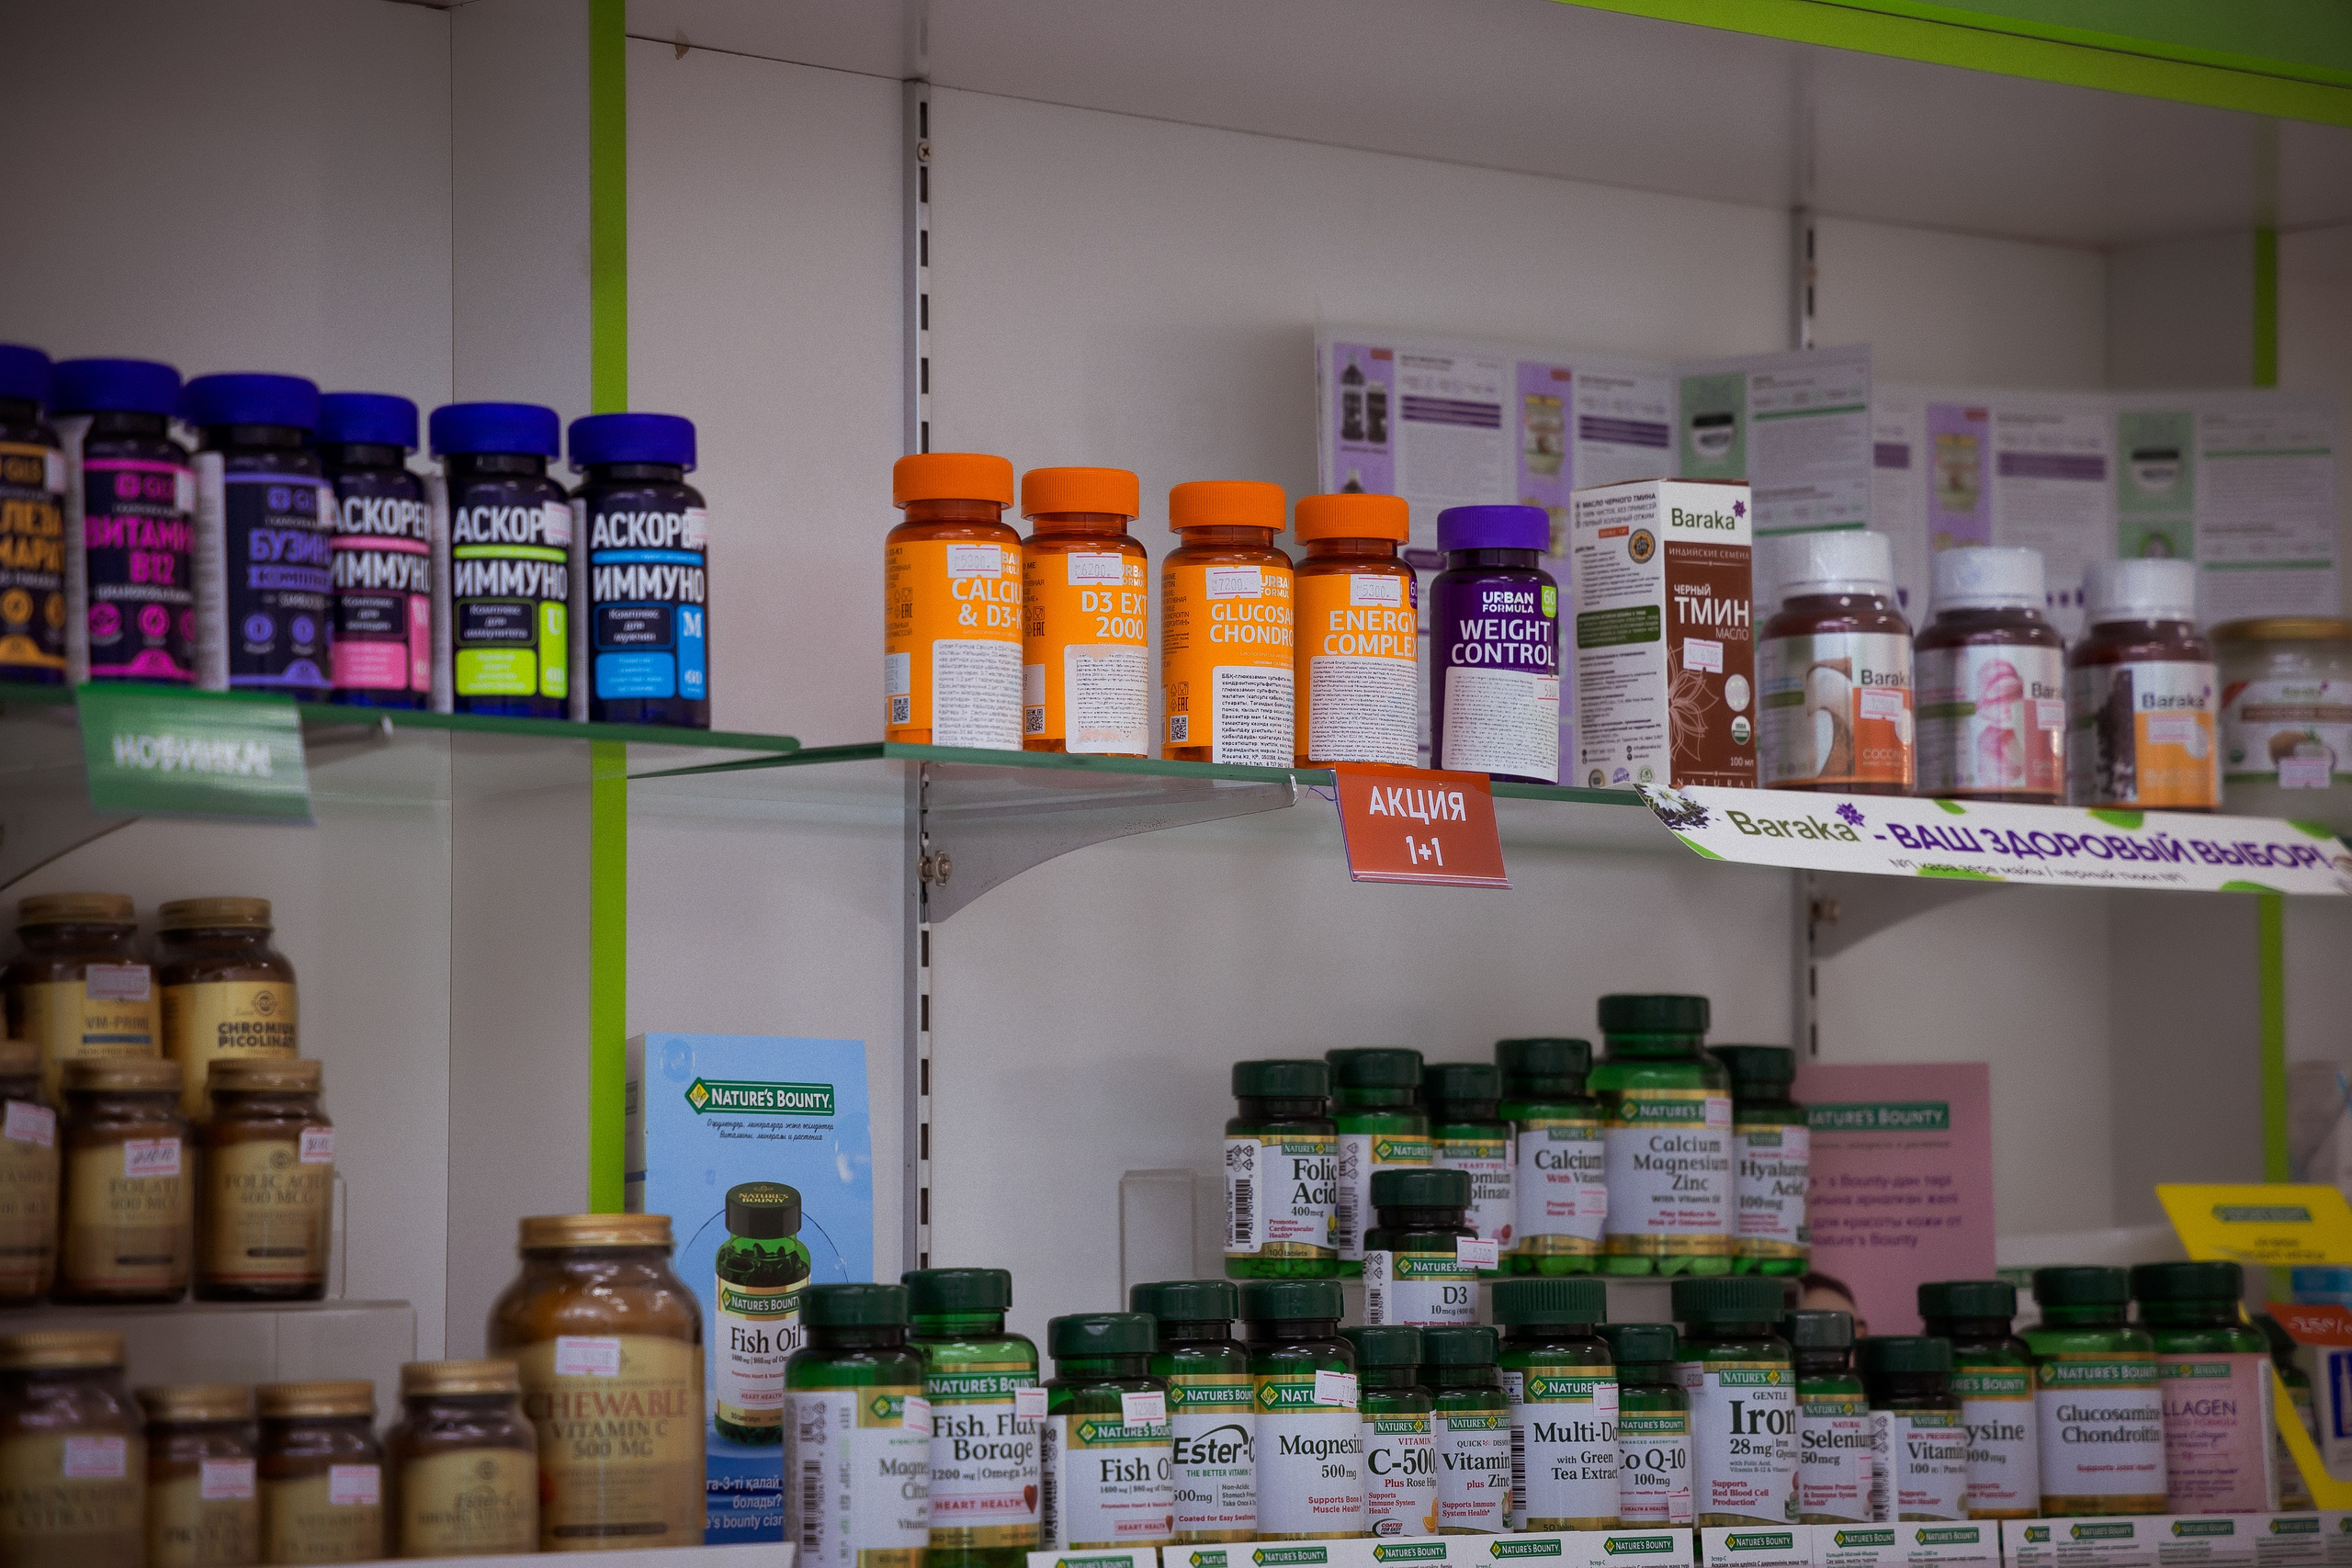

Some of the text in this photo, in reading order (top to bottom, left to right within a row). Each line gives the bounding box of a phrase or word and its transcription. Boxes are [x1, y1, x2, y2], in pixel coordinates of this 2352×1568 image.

[1671, 508, 1736, 530] Baraka
[454, 560, 568, 600] ИММУНО
[593, 566, 705, 604] ИММУНО
[951, 579, 1023, 605] CALCIU
[1674, 583, 1711, 595] ЧЕРНЫЙ
[1081, 591, 1113, 612] D3
[1482, 592, 1534, 605] URBAN
[957, 604, 978, 627] &
[1211, 604, 1294, 626] GLUCOSA
[1482, 604, 1534, 614] FORMULA
[1674, 596, 1749, 626] ТМИН
[1095, 615, 1144, 640] 2000
[1459, 618, 1551, 643] WEIGHT
[1715, 627, 1748, 640] МАСЛО
[1209, 624, 1294, 648] CHONDRO
[1451, 642, 1555, 667] CONTROL
[1369, 785, 1467, 825] АКЦИЯ
[1725, 810, 1860, 842] Baraka
[1979, 829, 2197, 864] ЗДОРОВЫЙ
[1405, 836, 1443, 866] 1+1
[711, 1088, 774, 1107] NATURE'S
[1293, 1158, 1337, 1181] Folic
[1671, 1175, 1708, 1190] Zinc
[1291, 1181, 1337, 1204] Acid
[1442, 1286, 1467, 1304] D3
[732, 1296, 768, 1311] NATURE'S
[730, 1324, 801, 1354] Fish Oil
[1723, 1372, 1766, 1384] NATURE'S
[1186, 1389, 1234, 1402] NATURE'S
[1753, 1392, 1787, 1400] GENTLE
[1451, 1419, 1486, 1429] NATURE'S
[1621, 1421, 1658, 1429] NATURE'S
[1728, 1400, 1796, 1435] Iron
[932, 1414, 990, 1438] Fish,
[1378, 1423, 1412, 1433] NATURE'S
[1963, 1419, 2025, 1447] ysine
[954, 1438, 1034, 1465] Borage
[1457, 1440, 1482, 1449] QUICK
[1730, 1438, 1772, 1458] 28 mg
[1368, 1448, 1436, 1475] C-500
[1442, 1452, 1510, 1471] Vitamin
[1556, 1451, 1613, 1464] with Green
[1645, 1448, 1686, 1473] Q-10
[1100, 1457, 1150, 1482] Fish
[1202, 1469, 1227, 1477] BETTER
[1551, 1467, 1577, 1481] Tea
[746, 1474, 779, 1491] қалай
[1385, 1479, 1404, 1488] Plus
[1407, 1477, 1425, 1488] Rose
[1466, 1473, 1510, 1490] plus Zinc
[1713, 1481, 1747, 1491] Supports
[733, 1494, 782, 1510] болады?
[934, 1500, 976, 1510] HEART
[1308, 1497, 1344, 1506] Supports
[1369, 1493, 1396, 1501] Supports
[1396, 1499, 1416, 1510] System
[1442, 1500, 1496, 1509] Supports Immune
[1313, 1506, 1340, 1514] Muscle
[1442, 1509, 1466, 1518] System
[723, 1514, 761, 1530] bounty
[1219, 1514, 1233, 1523] Easy
[1615, 1541, 1645, 1551] NATURE'S
[1736, 1538, 1765, 1548] NATURE'S
[1846, 1533, 1872, 1543] NATURE'S
[1385, 1546, 1416, 1557] NATURE'S
[1502, 1543, 1532, 1554] NATURE'S
[1264, 1552, 1296, 1562] NATURE'S
